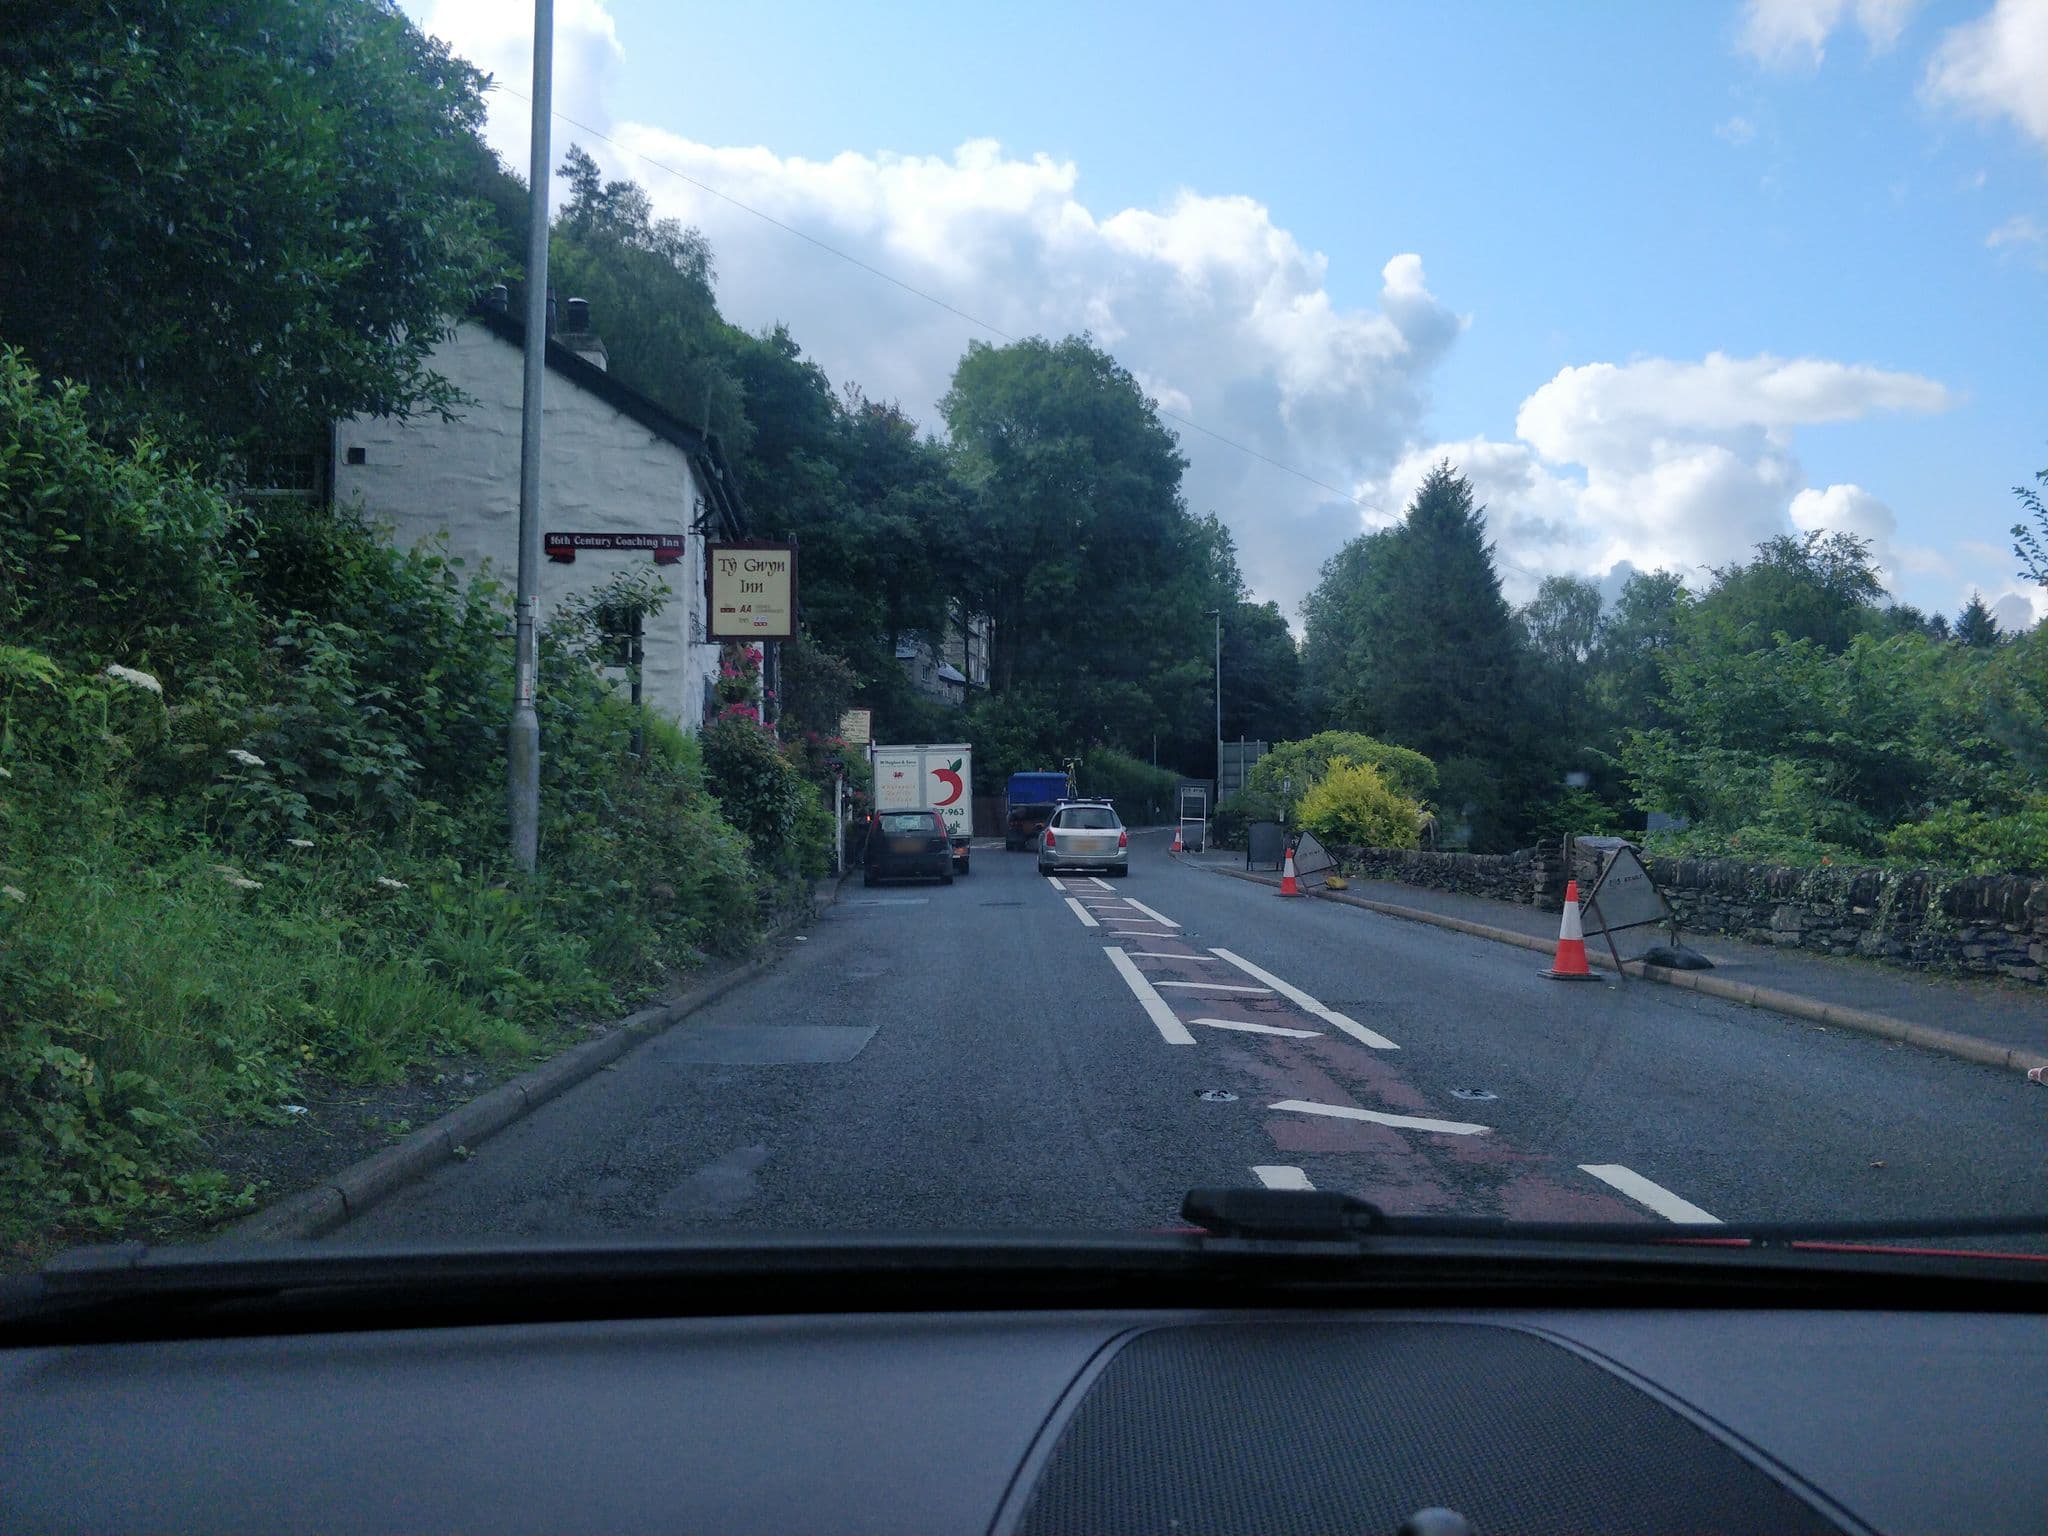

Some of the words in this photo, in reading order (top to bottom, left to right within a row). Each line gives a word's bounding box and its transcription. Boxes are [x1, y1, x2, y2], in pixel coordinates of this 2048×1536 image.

[550, 535, 571, 546] 16th
[574, 535, 612, 548] Century
[615, 536, 659, 549] Coaching
[662, 537, 681, 548] Inn
[743, 558, 786, 577] Gwyn
[739, 579, 764, 594] Inn
[739, 604, 752, 614] AA
